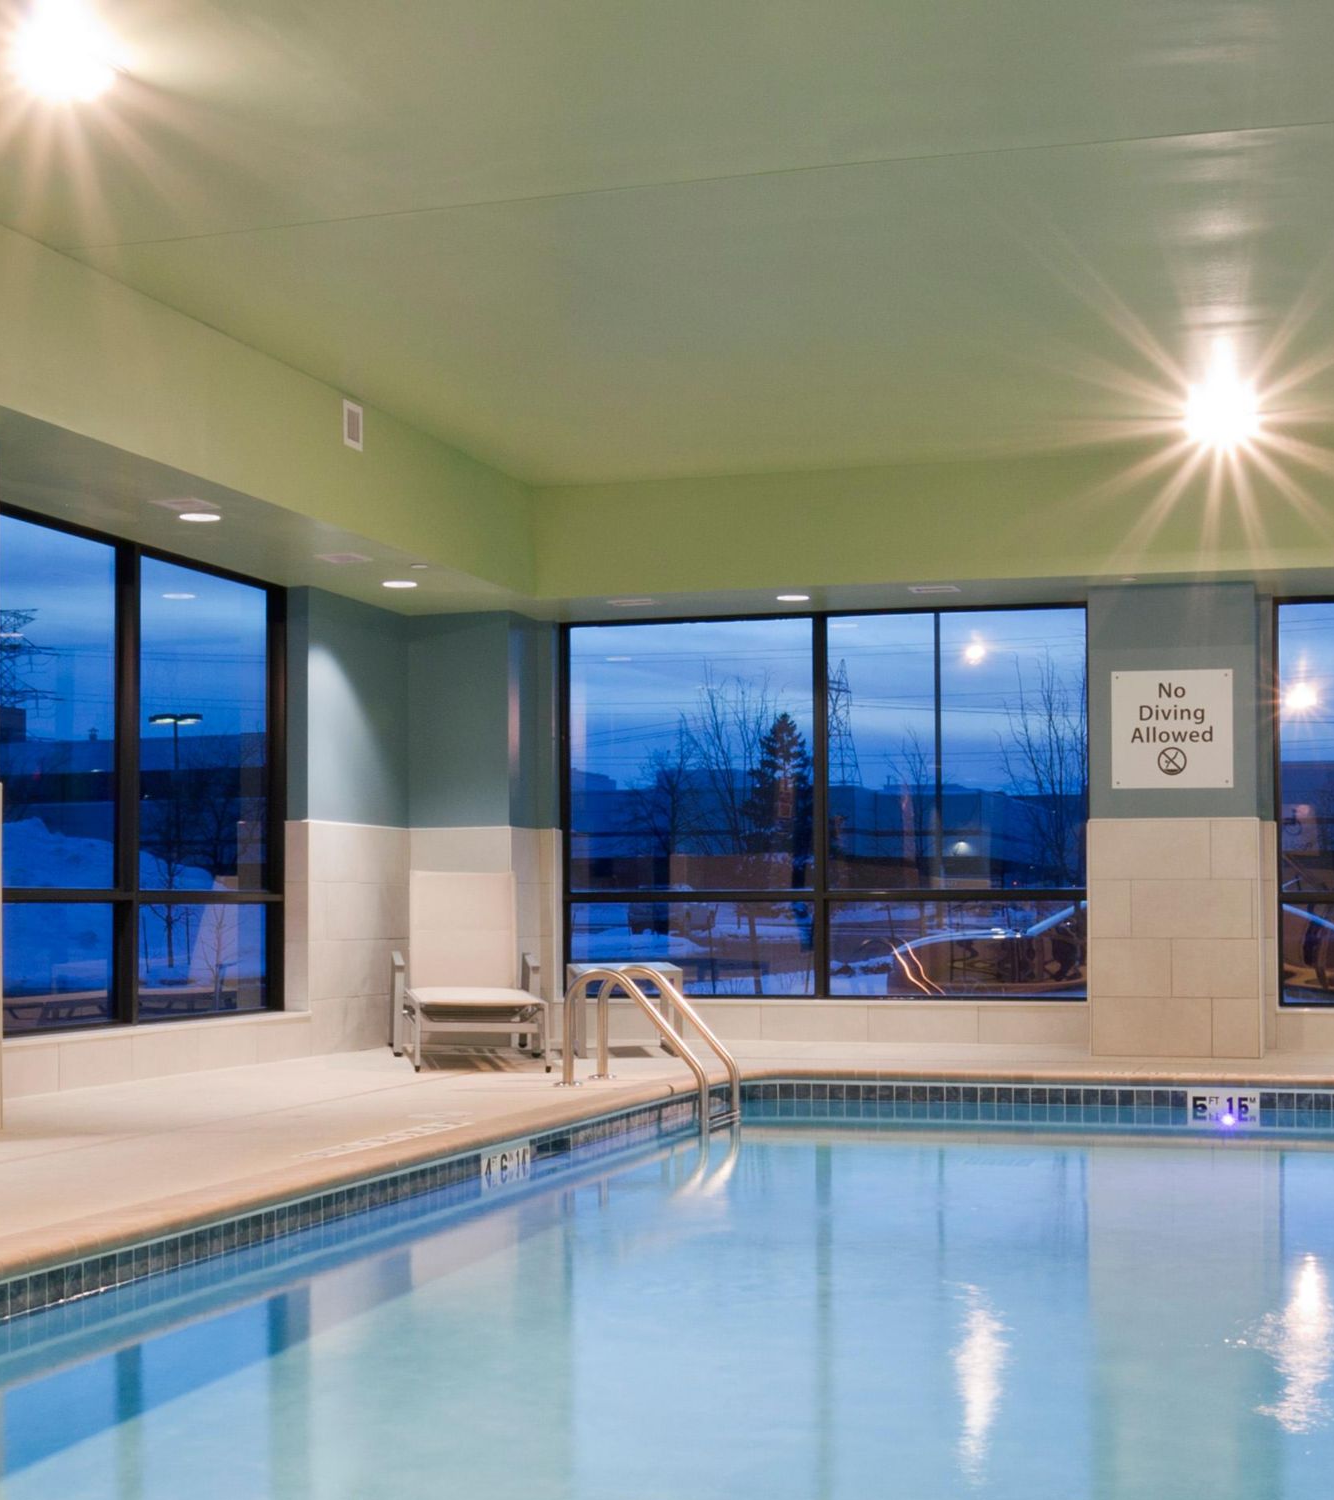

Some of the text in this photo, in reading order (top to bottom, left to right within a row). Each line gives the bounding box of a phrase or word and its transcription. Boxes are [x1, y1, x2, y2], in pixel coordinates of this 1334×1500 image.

[1158, 682, 1186, 698] No
[1139, 704, 1205, 724] Diving
[1131, 726, 1213, 743] Allowed
